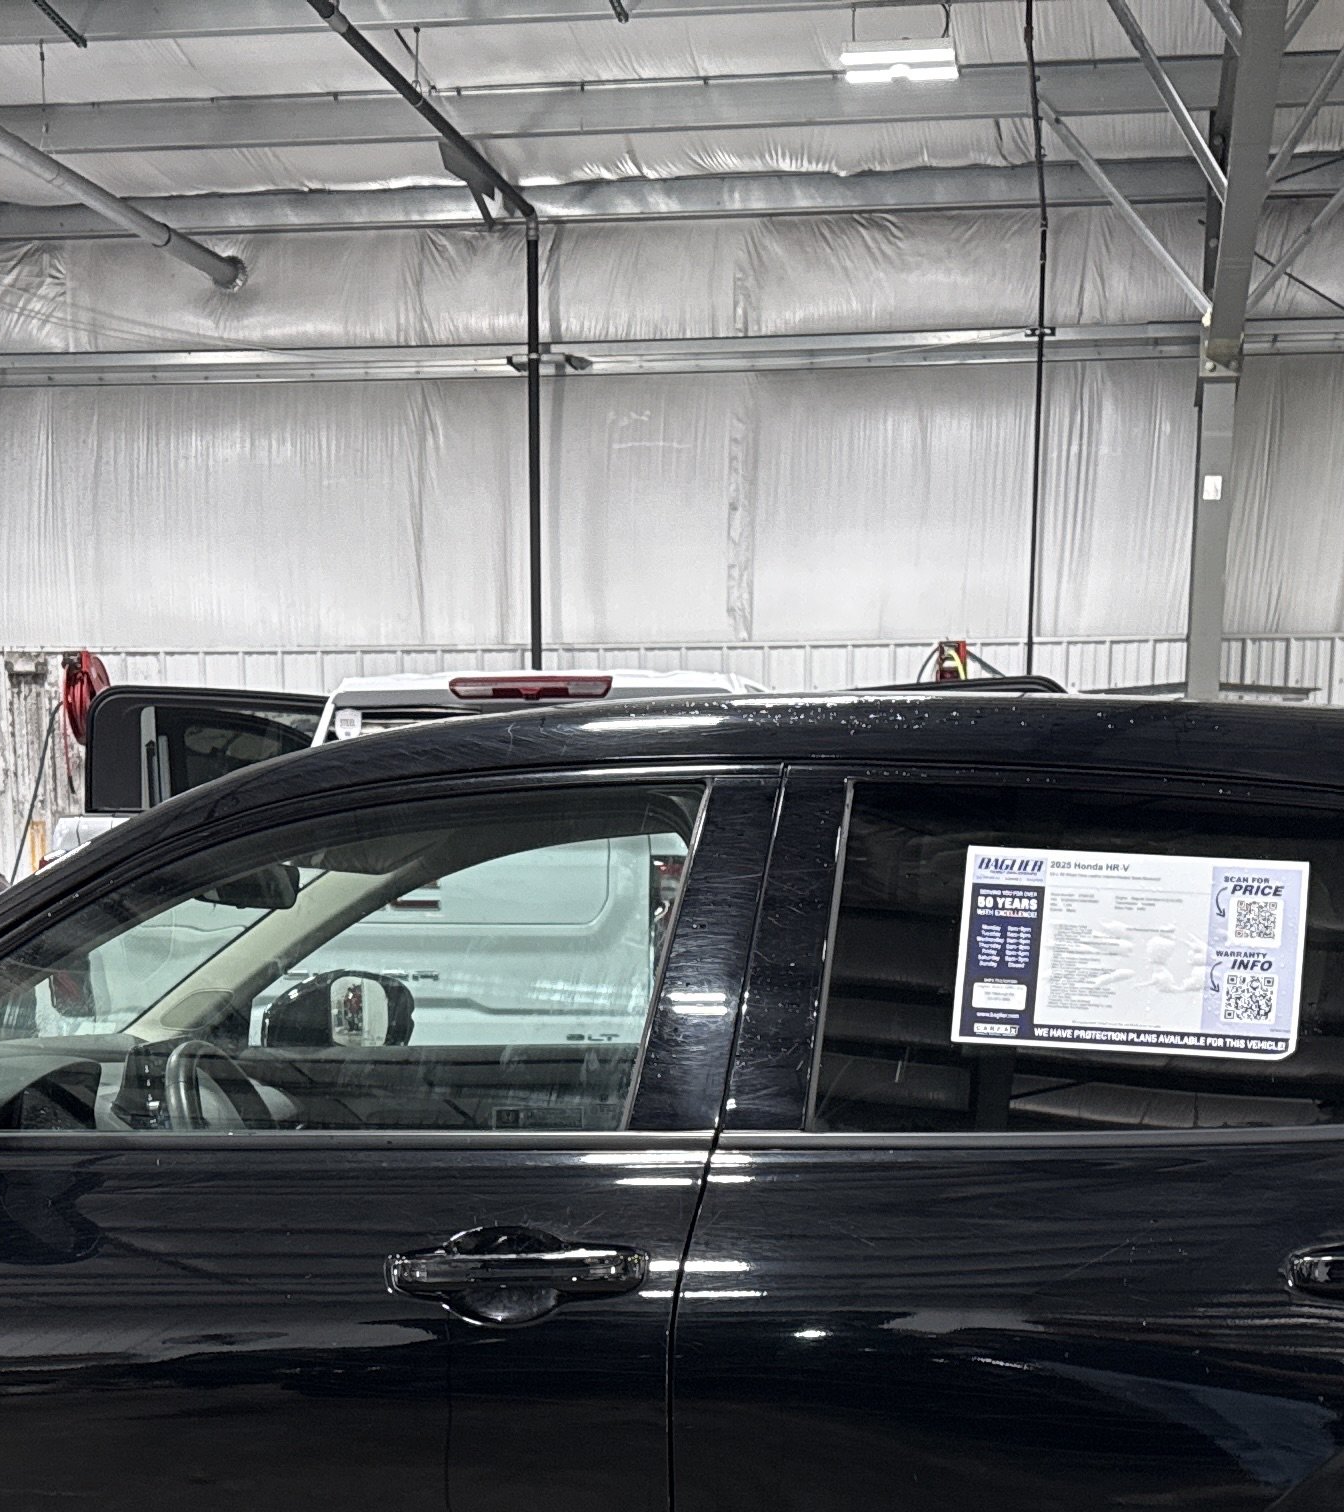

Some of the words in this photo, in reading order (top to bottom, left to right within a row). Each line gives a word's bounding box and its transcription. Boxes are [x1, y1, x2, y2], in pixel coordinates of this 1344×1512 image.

[1050, 860, 1071, 869] 2025
[1074, 862, 1103, 871] Honda
[1105, 863, 1130, 872] HR-V
[1223, 875, 1249, 883] SCAN
[1230, 884, 1285, 897] PRICE
[977, 896, 994, 908] 50
[996, 897, 1038, 911] YEARS
[1216, 950, 1267, 959] WARRANTY
[1230, 959, 1273, 972] INFO
[1034, 1028, 1049, 1037] WE
[1049, 1028, 1073, 1039] HAVE
[1074, 1029, 1128, 1041] PROTECTION
[1128, 1032, 1157, 1043] PLANS
[1158, 1034, 1206, 1047] AVAILABLE
[1206, 1037, 1224, 1048] FOR
[1225, 1038, 1246, 1049] THIS
[1246, 1040, 1286, 1051] VEHICLE!
